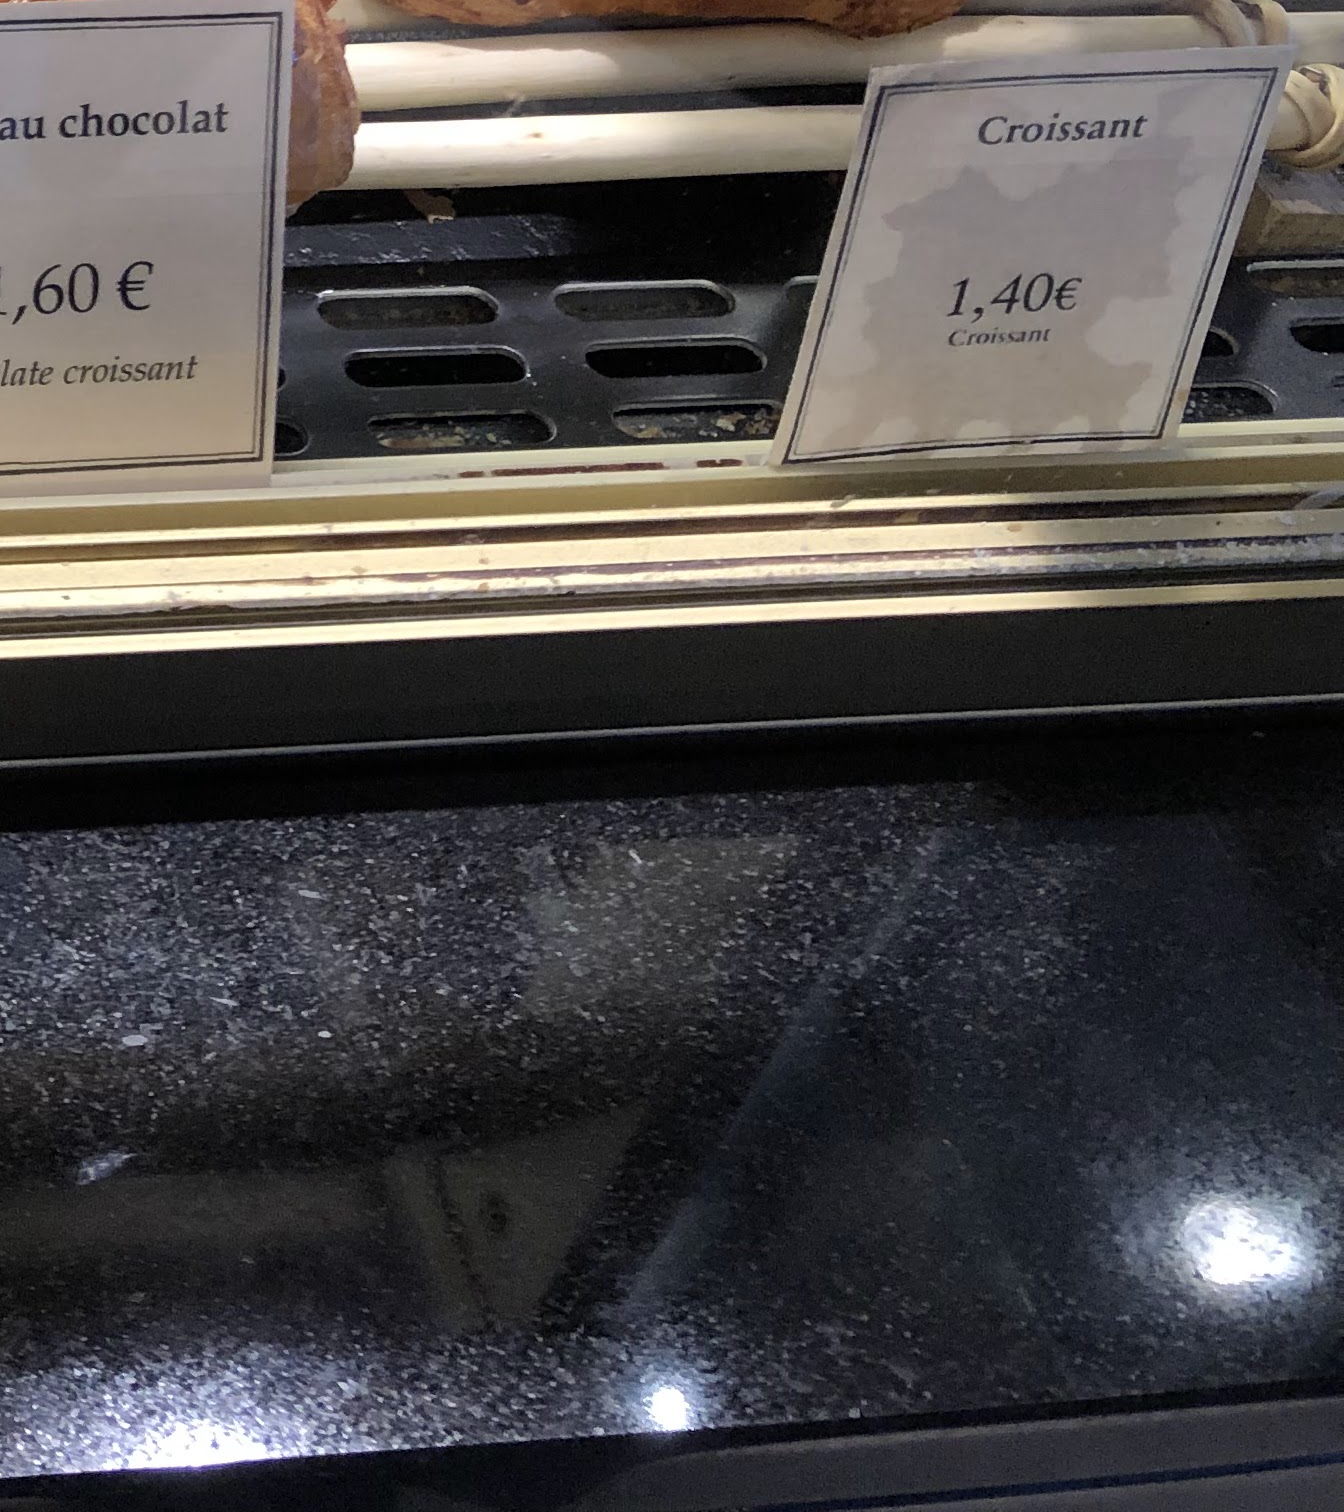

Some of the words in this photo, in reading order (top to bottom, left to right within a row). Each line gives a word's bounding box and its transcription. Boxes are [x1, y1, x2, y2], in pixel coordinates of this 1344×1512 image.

[58, 99, 229, 138] chocolat
[977, 113, 1148, 146] Croissant
[947, 272, 1082, 324] 1,40€
[947, 327, 1050, 348] Croissant
[63, 354, 198, 384] croissant
